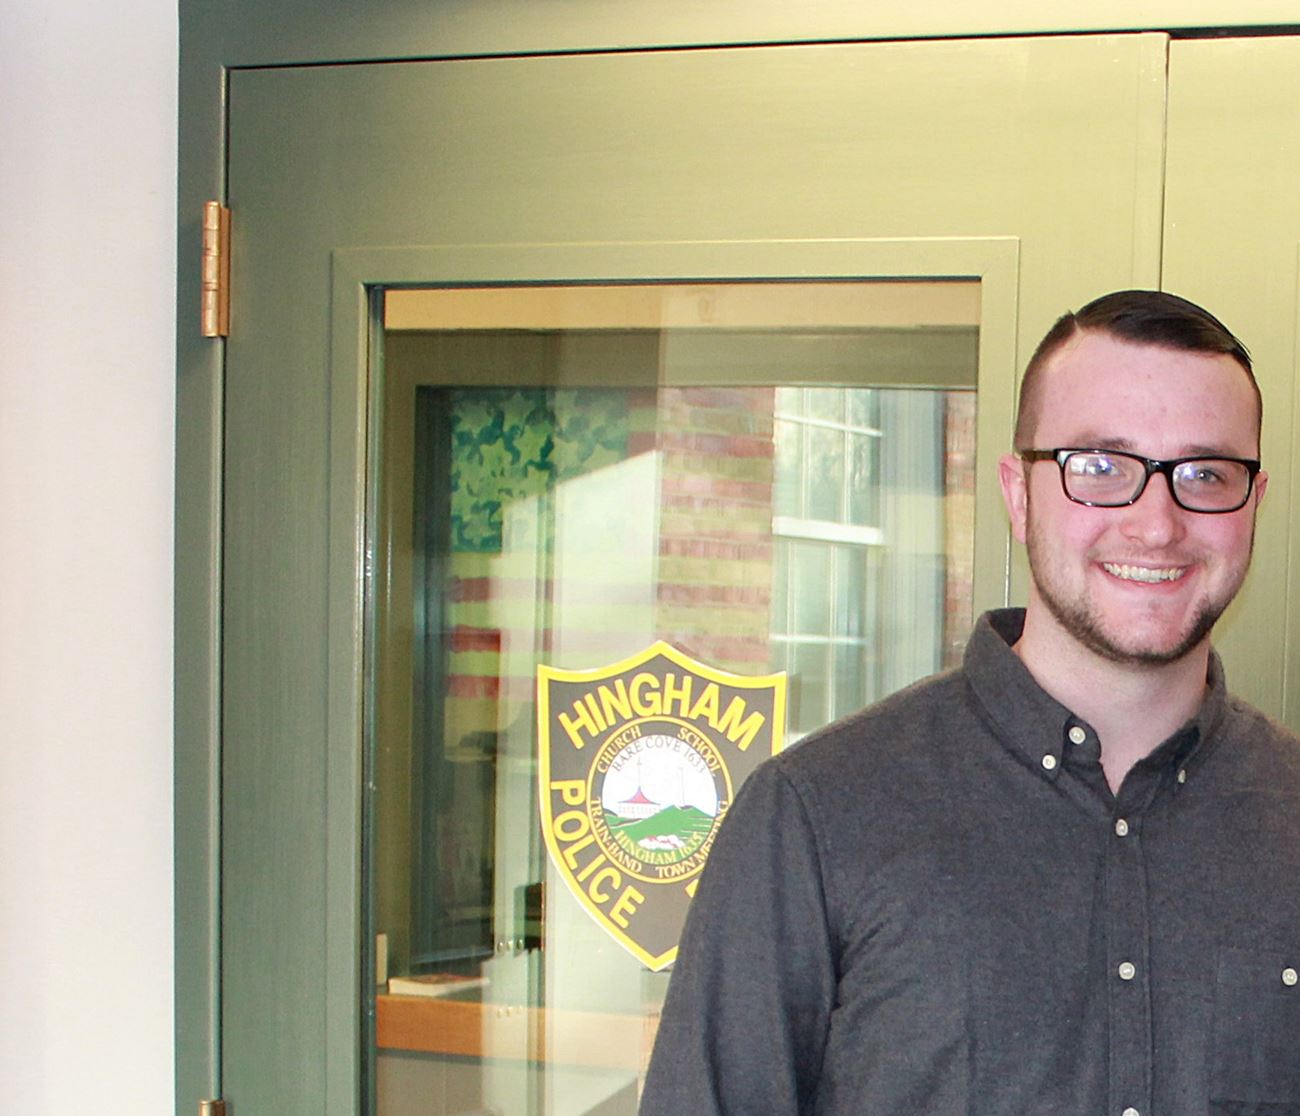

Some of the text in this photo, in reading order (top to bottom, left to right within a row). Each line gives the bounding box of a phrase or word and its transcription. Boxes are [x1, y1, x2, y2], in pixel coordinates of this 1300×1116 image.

[558, 673, 766, 752] HINGHAM
[596, 725, 721, 778] CHURCH SCHOOL
[645, 736, 681, 753] COVE
[550, 779, 645, 929] POLICE
[614, 829, 677, 865] HINGHAM
[655, 856, 698, 879] TOWN
